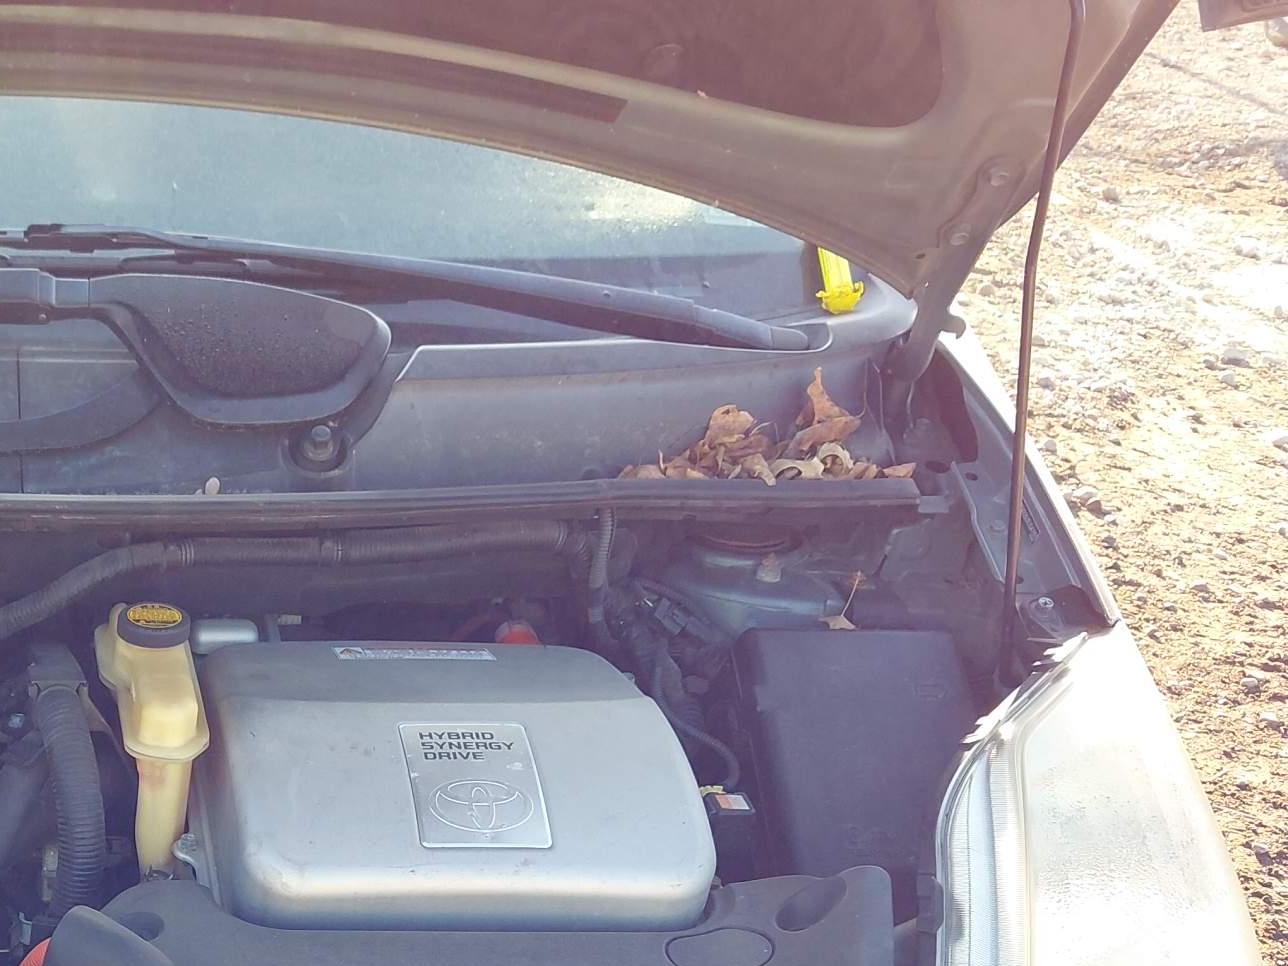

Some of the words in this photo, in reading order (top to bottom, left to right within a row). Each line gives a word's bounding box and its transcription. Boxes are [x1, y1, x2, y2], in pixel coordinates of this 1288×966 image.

[418, 732, 494, 740] HYBRID
[420, 742, 514, 750] SYNERGY
[423, 752, 485, 760] DRIVE
